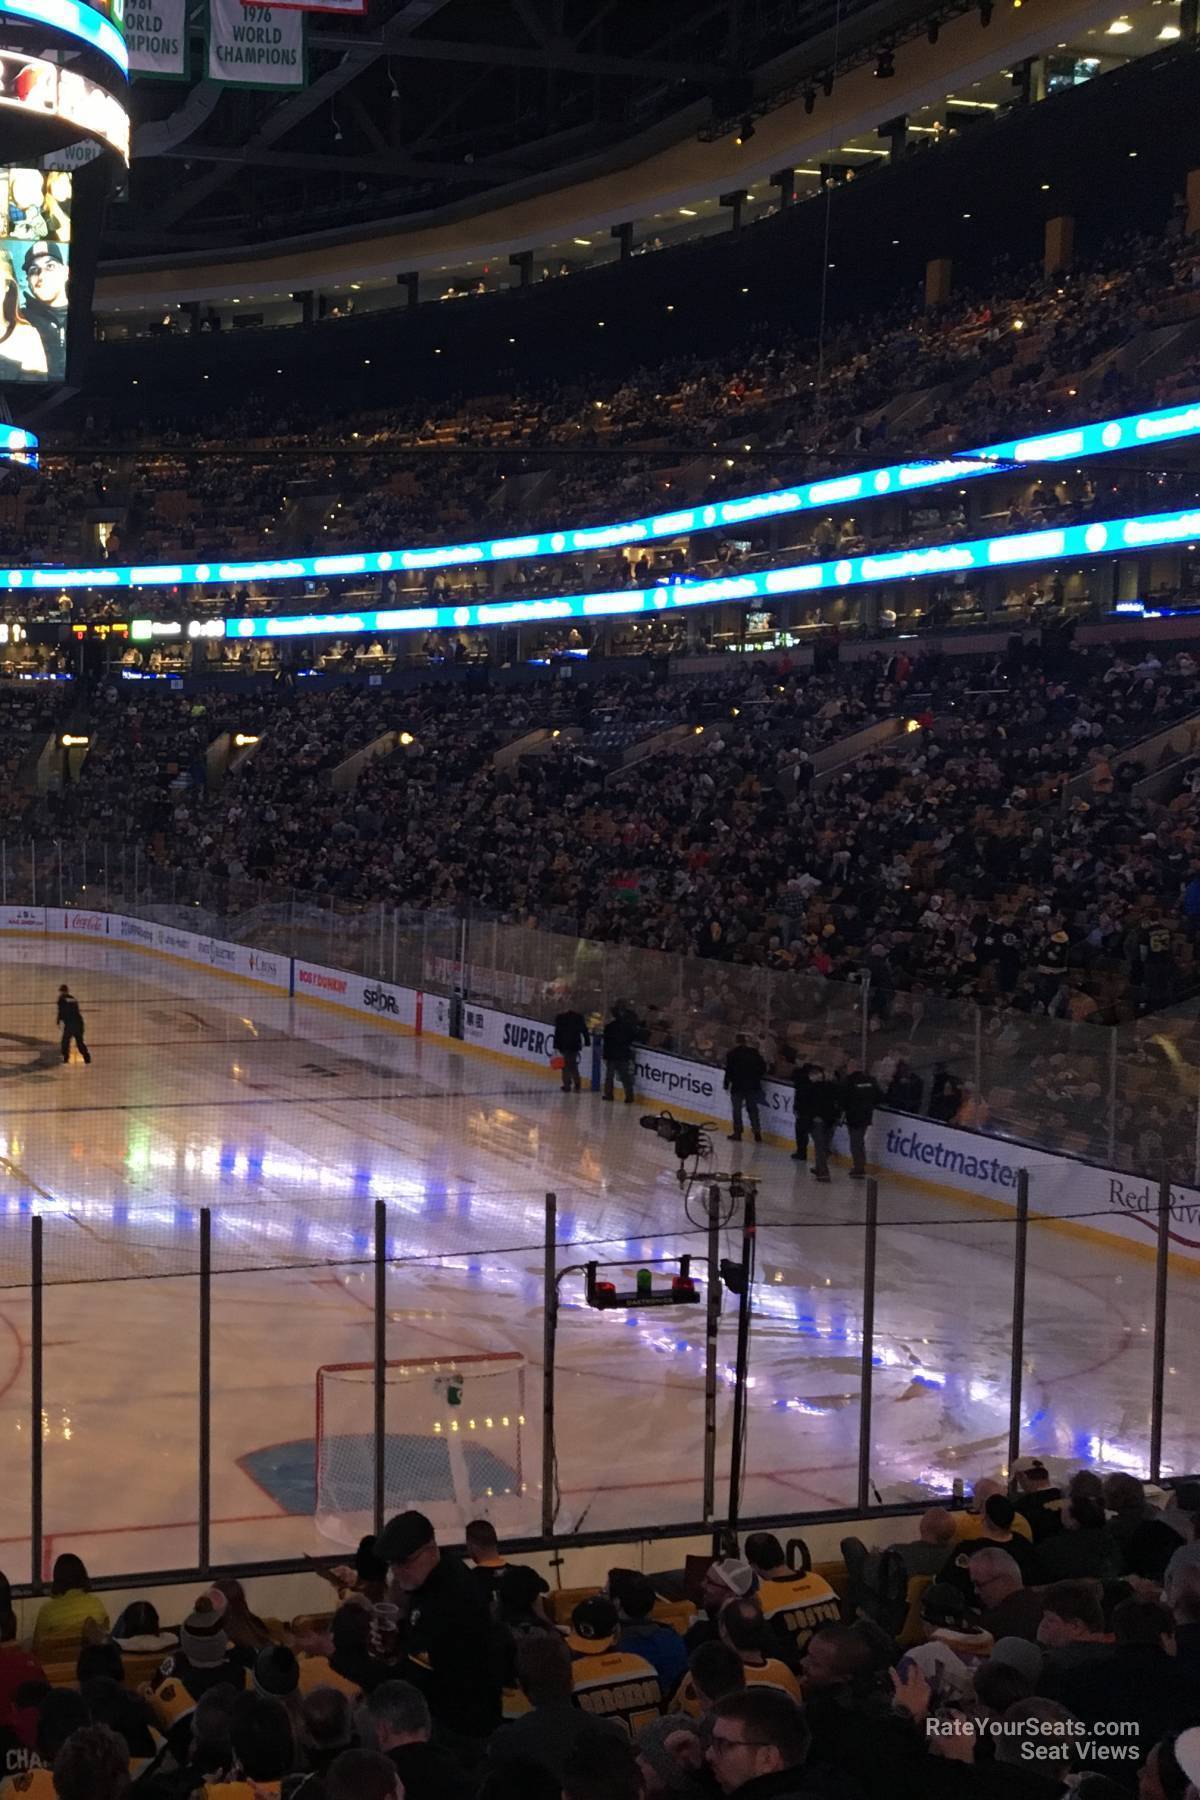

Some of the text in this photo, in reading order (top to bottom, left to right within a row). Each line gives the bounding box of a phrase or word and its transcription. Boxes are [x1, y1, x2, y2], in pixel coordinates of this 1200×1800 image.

[126, 13, 162, 32] ORLD
[243, 6, 272, 23] 1976
[126, 34, 179, 55] MPIONS
[233, 25, 282, 44] WORLD
[216, 45, 297, 65] CHAMPIONS
[65, 147, 98, 160] WORL
[632, 1061, 713, 1097] nterprise
[1108, 1178, 1200, 1225] Red Riv
[5, 1748, 48, 1770] CHA
